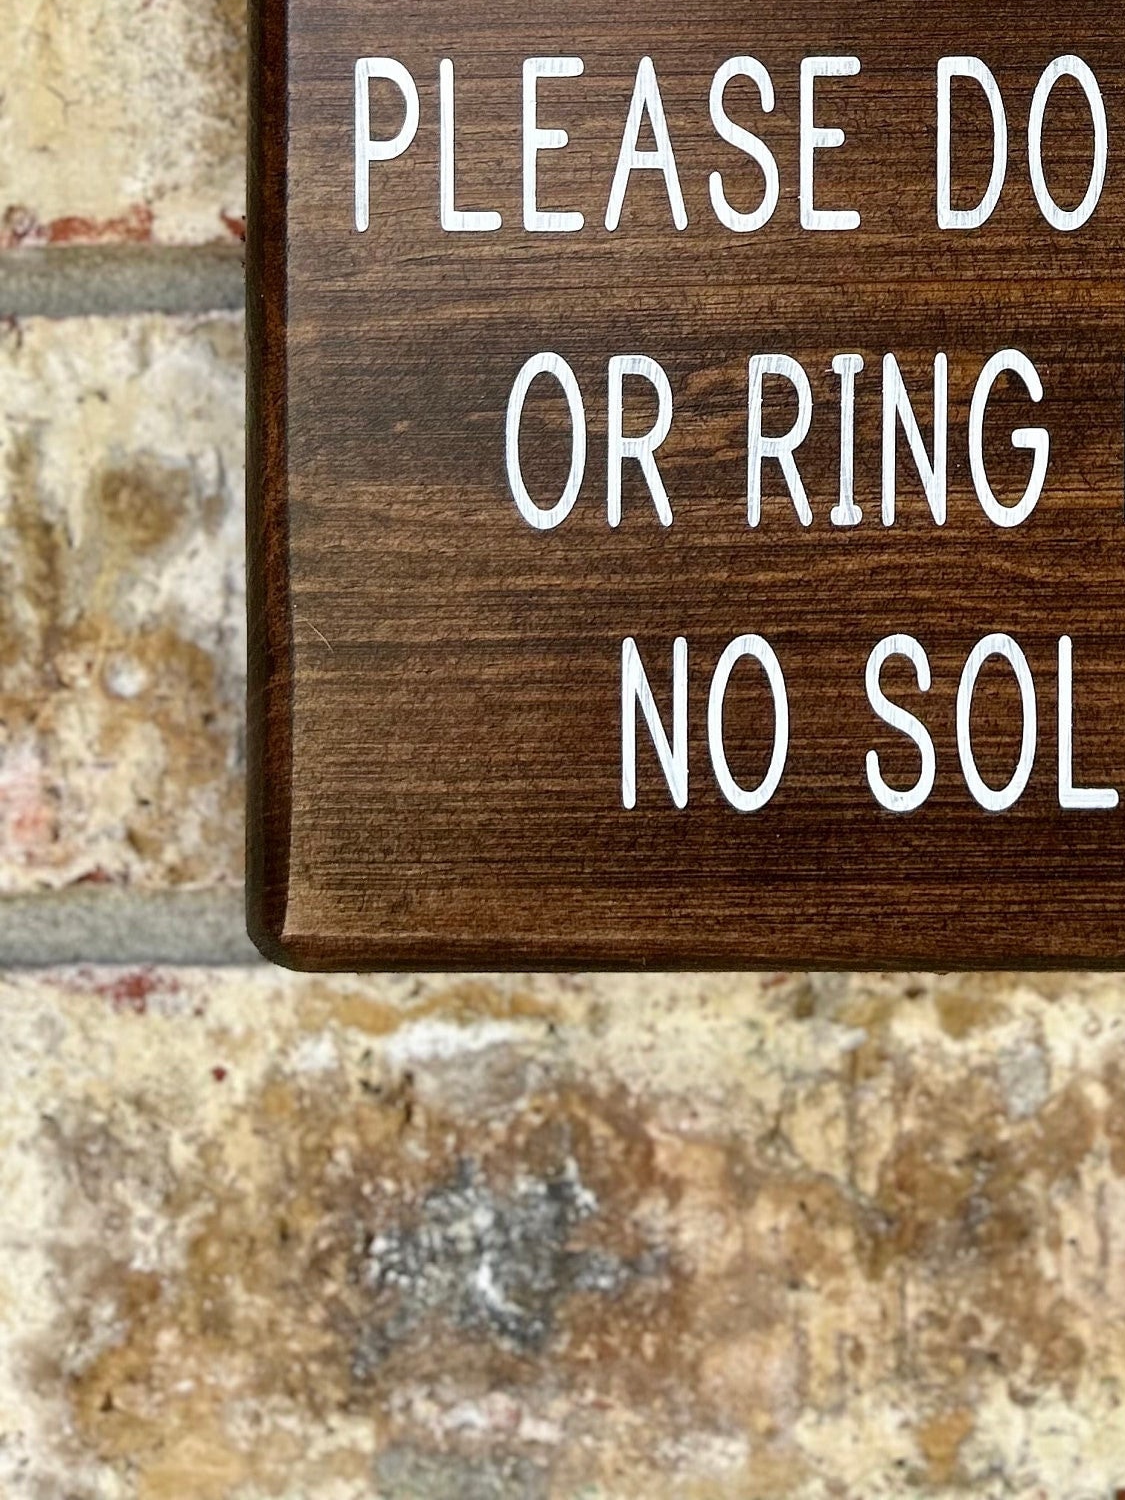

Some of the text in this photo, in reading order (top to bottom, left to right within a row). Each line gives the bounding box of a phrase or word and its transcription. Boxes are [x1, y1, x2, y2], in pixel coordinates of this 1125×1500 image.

[349, 56, 860, 232] PLEASE
[936, 55, 1108, 231] DO
[506, 352, 673, 529] OR
[747, 349, 1049, 527] RING
[622, 634, 788, 811] NO
